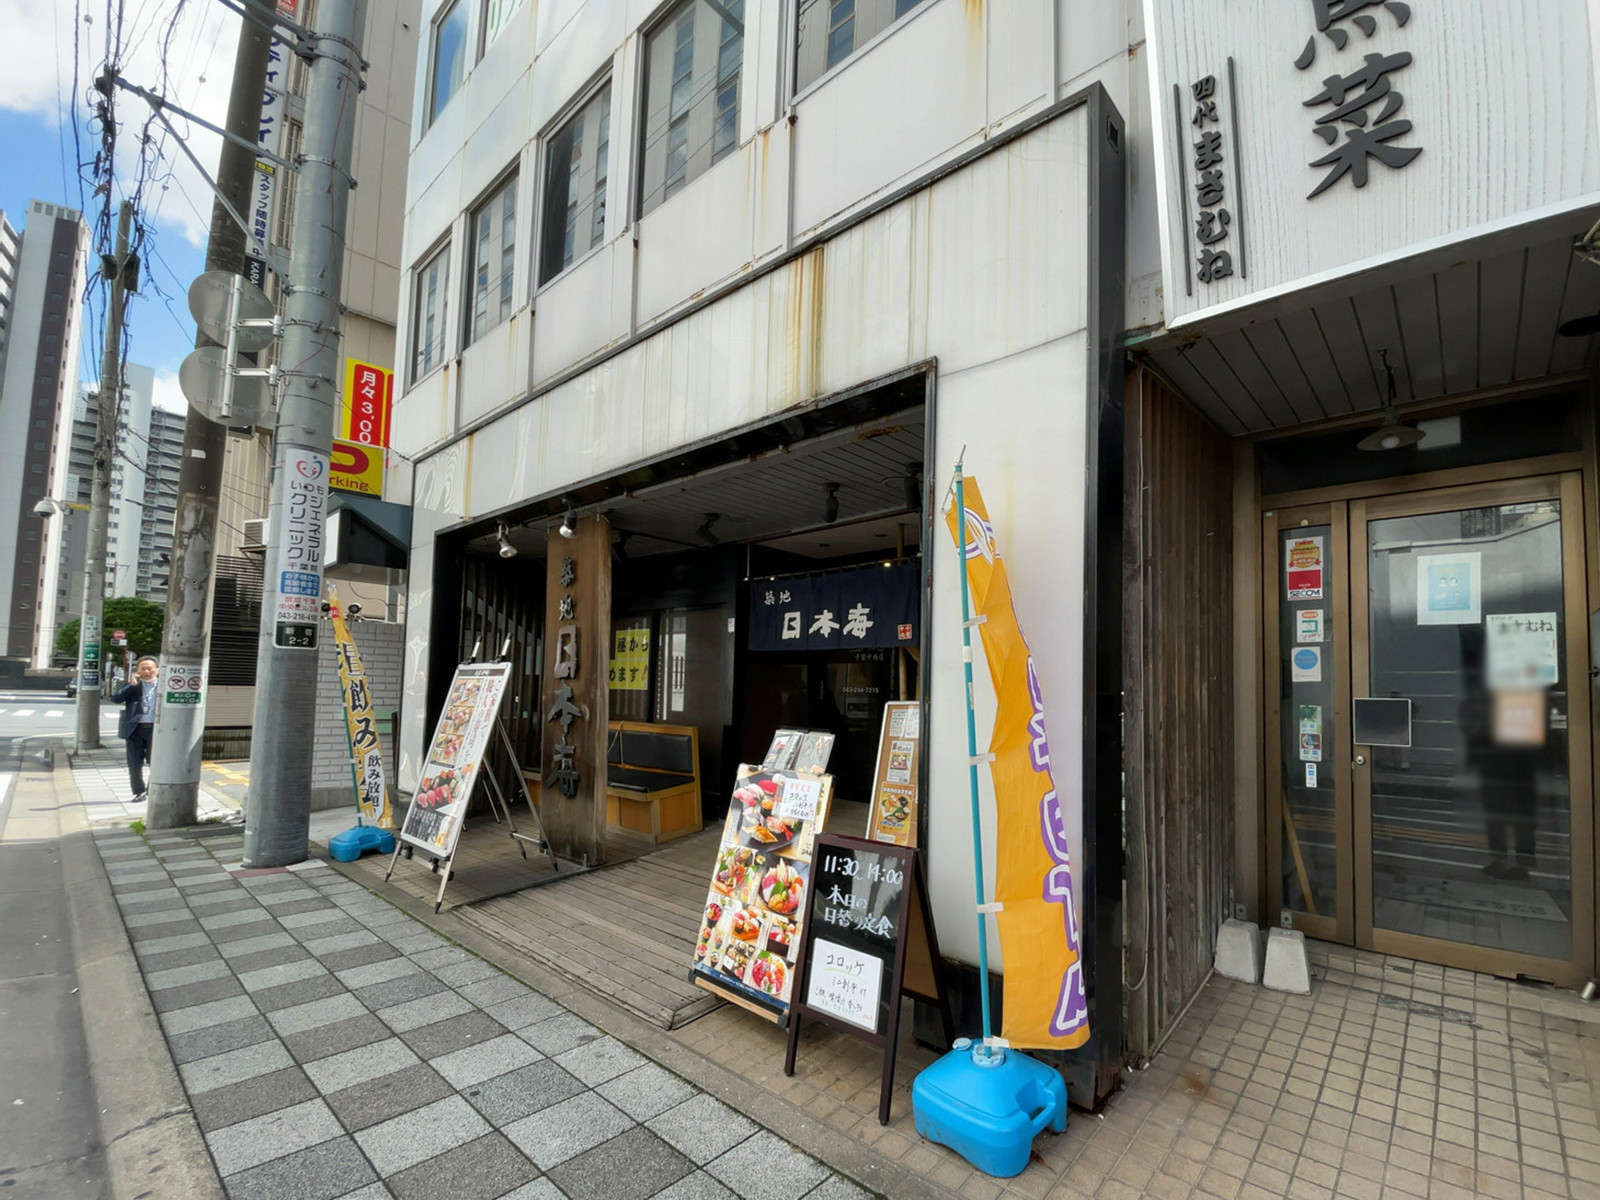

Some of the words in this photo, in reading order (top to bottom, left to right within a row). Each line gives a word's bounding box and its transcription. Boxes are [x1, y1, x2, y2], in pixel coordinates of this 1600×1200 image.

[1191, 75, 1233, 283] 四代まさむね
[329, 476, 369, 492] rking
[287, 493, 307, 559] クリニック
[764, 590, 792, 606] 築地
[782, 603, 874, 640] 日本海
[289, 637, 309, 645] 2-2
[170, 667, 185, 675] NO
[826, 884, 868, 910] 本日の
[826, 954, 865, 977] コロッケ
